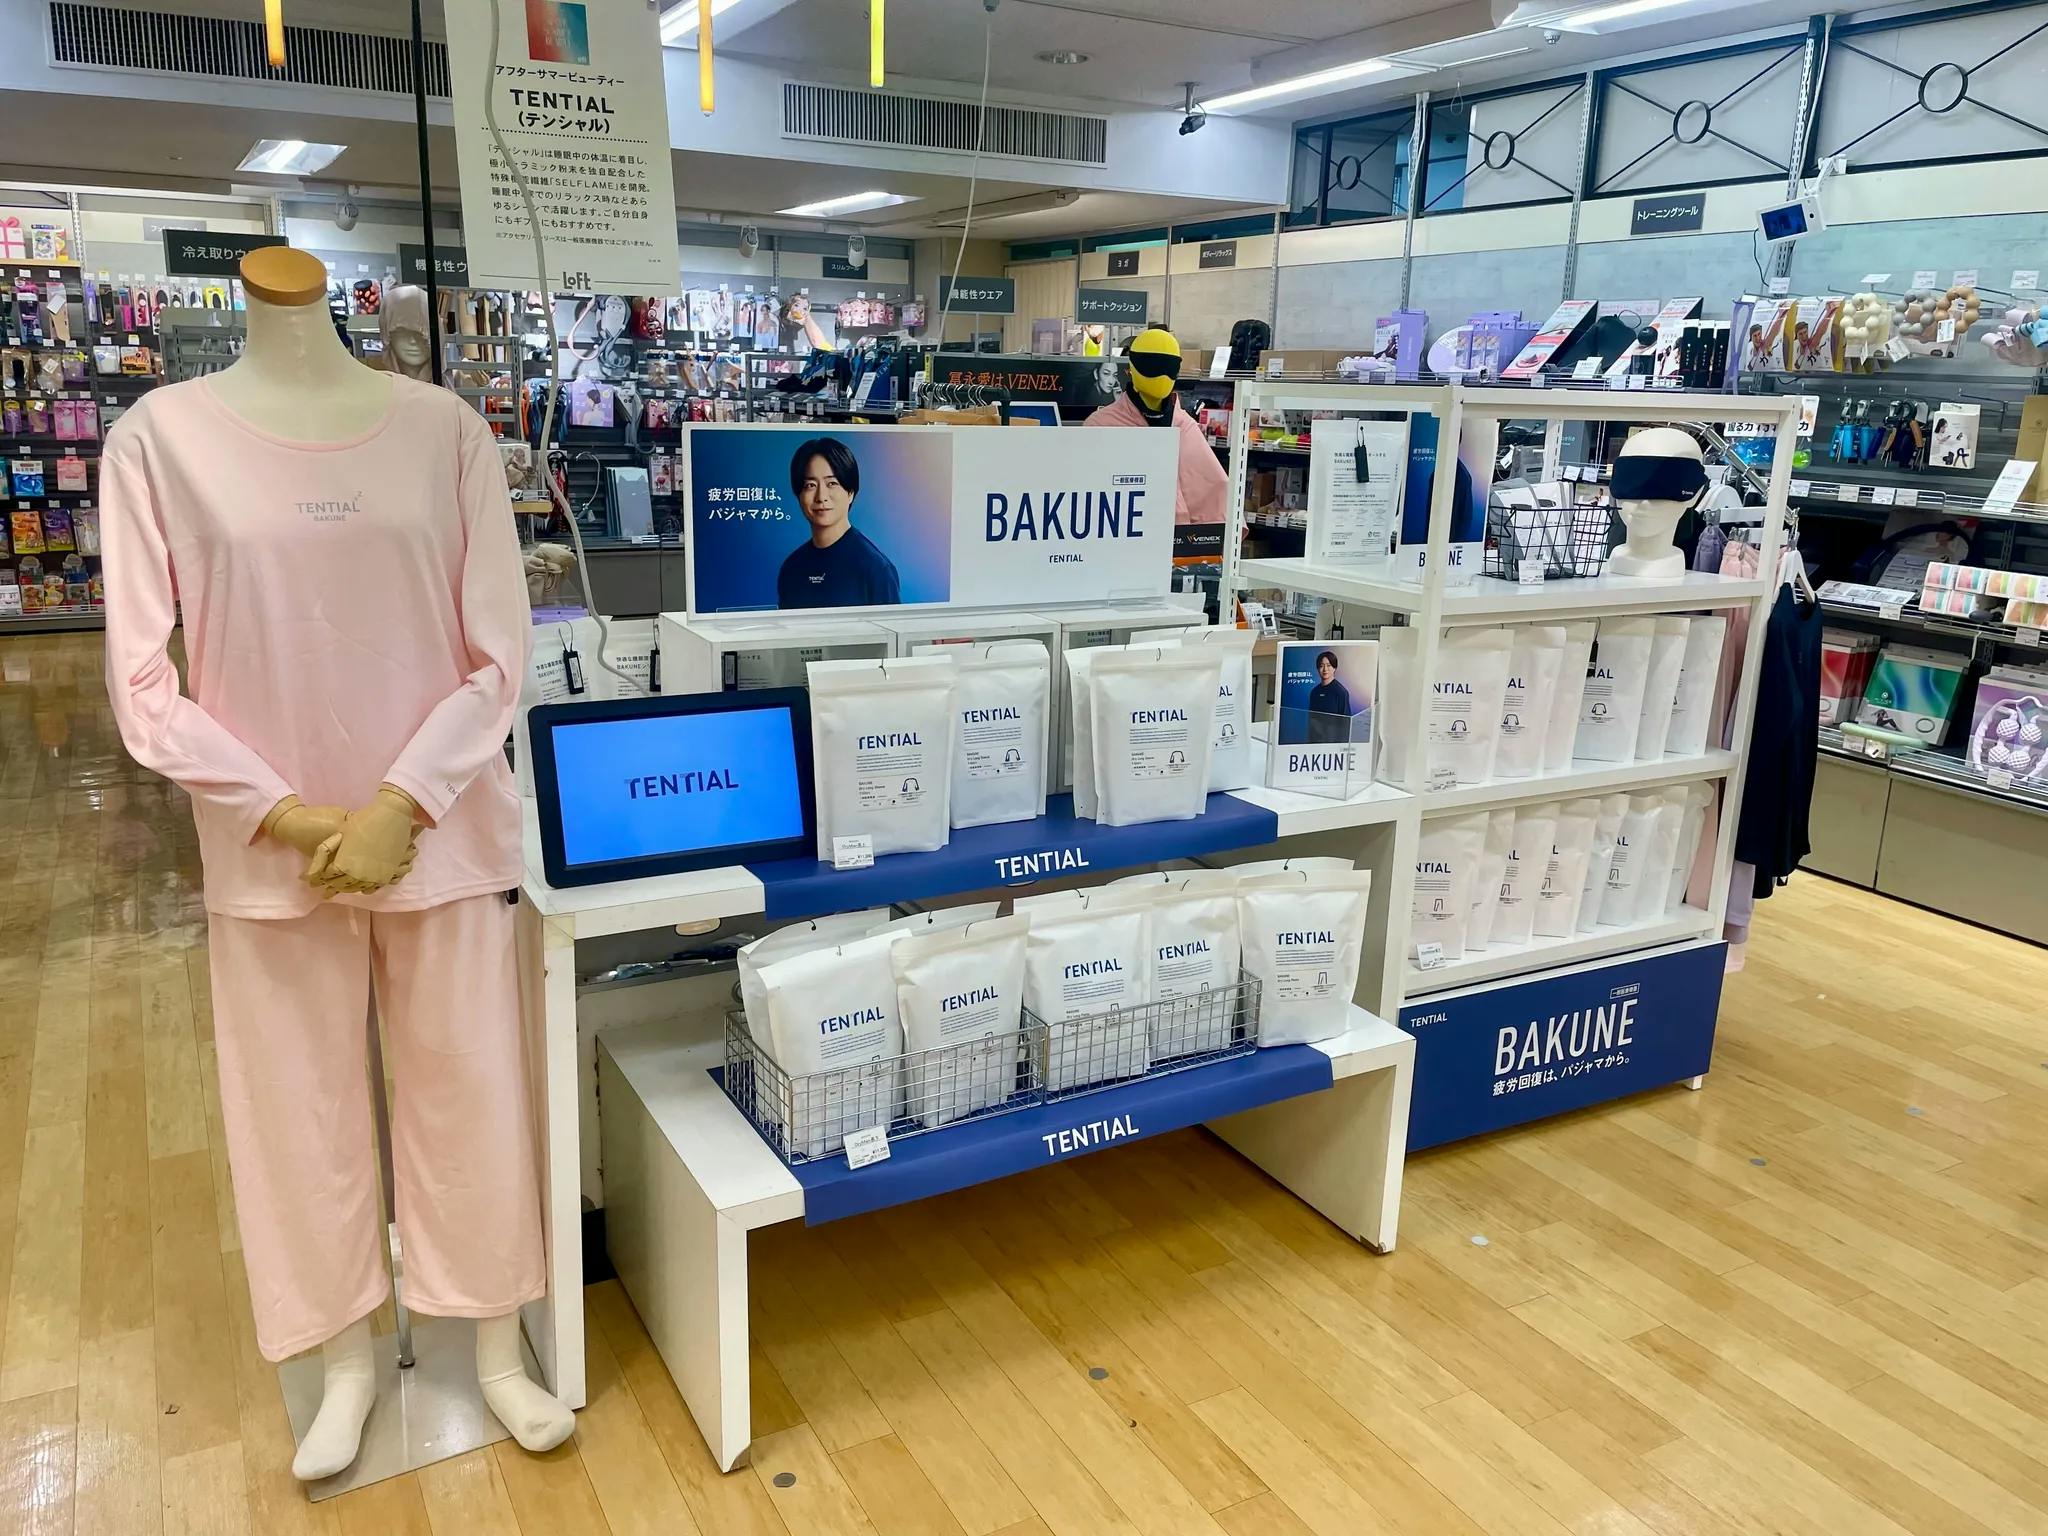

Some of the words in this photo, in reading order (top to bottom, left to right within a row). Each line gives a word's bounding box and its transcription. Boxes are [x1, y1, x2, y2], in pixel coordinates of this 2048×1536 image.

[496, 65, 625, 86] アフターサマービューティー
[509, 88, 615, 114] TENTIAL
[518, 111, 610, 134] (テンシャル)
[488, 144, 648, 166] 「テシャル」は睡眠中の体温に着目し、
[489, 159, 646, 179] 極小ラミック粉末を独自配合した
[1637, 205, 1699, 221] トレーニングツール
[494, 216, 616, 232] にもギフにもおすすめです。
[182, 245, 252, 260] 冷え取りウ
[1081, 300, 1143, 312] サポートクッション
[707, 487, 782, 502] 疲労回復は、
[296, 501, 361, 513] TENTIAL
[708, 507, 793, 521] パジャマから。
[985, 490, 1146, 542] BAKUNE
[313, 514, 347, 522] BAKUNE
[1049, 554, 1084, 563] TENTIAL
[962, 706, 1021, 724] TENTIAL
[1130, 708, 1188, 724] TENTIAL
[857, 732, 922, 750] TENTIAL
[1289, 752, 1357, 772] BAKUNE
[624, 768, 739, 799] TENTIAL
[994, 847, 1090, 879] TENTIAL
[1275, 931, 1335, 946] TENTIAL
[1158, 939, 1211, 961] TENTIAL
[1063, 958, 1123, 979] TENTIAL
[939, 985, 998, 1012] TENTIAL
[818, 1006, 885, 1035] TENTIAL
[1410, 1012, 1448, 1028] TENTIAL
[1494, 998, 1639, 1077] BAKUNE
[1492, 1053, 1631, 1097] 疲労回復は、パジャマから。
[1042, 1113, 1140, 1157] TENTIAL
